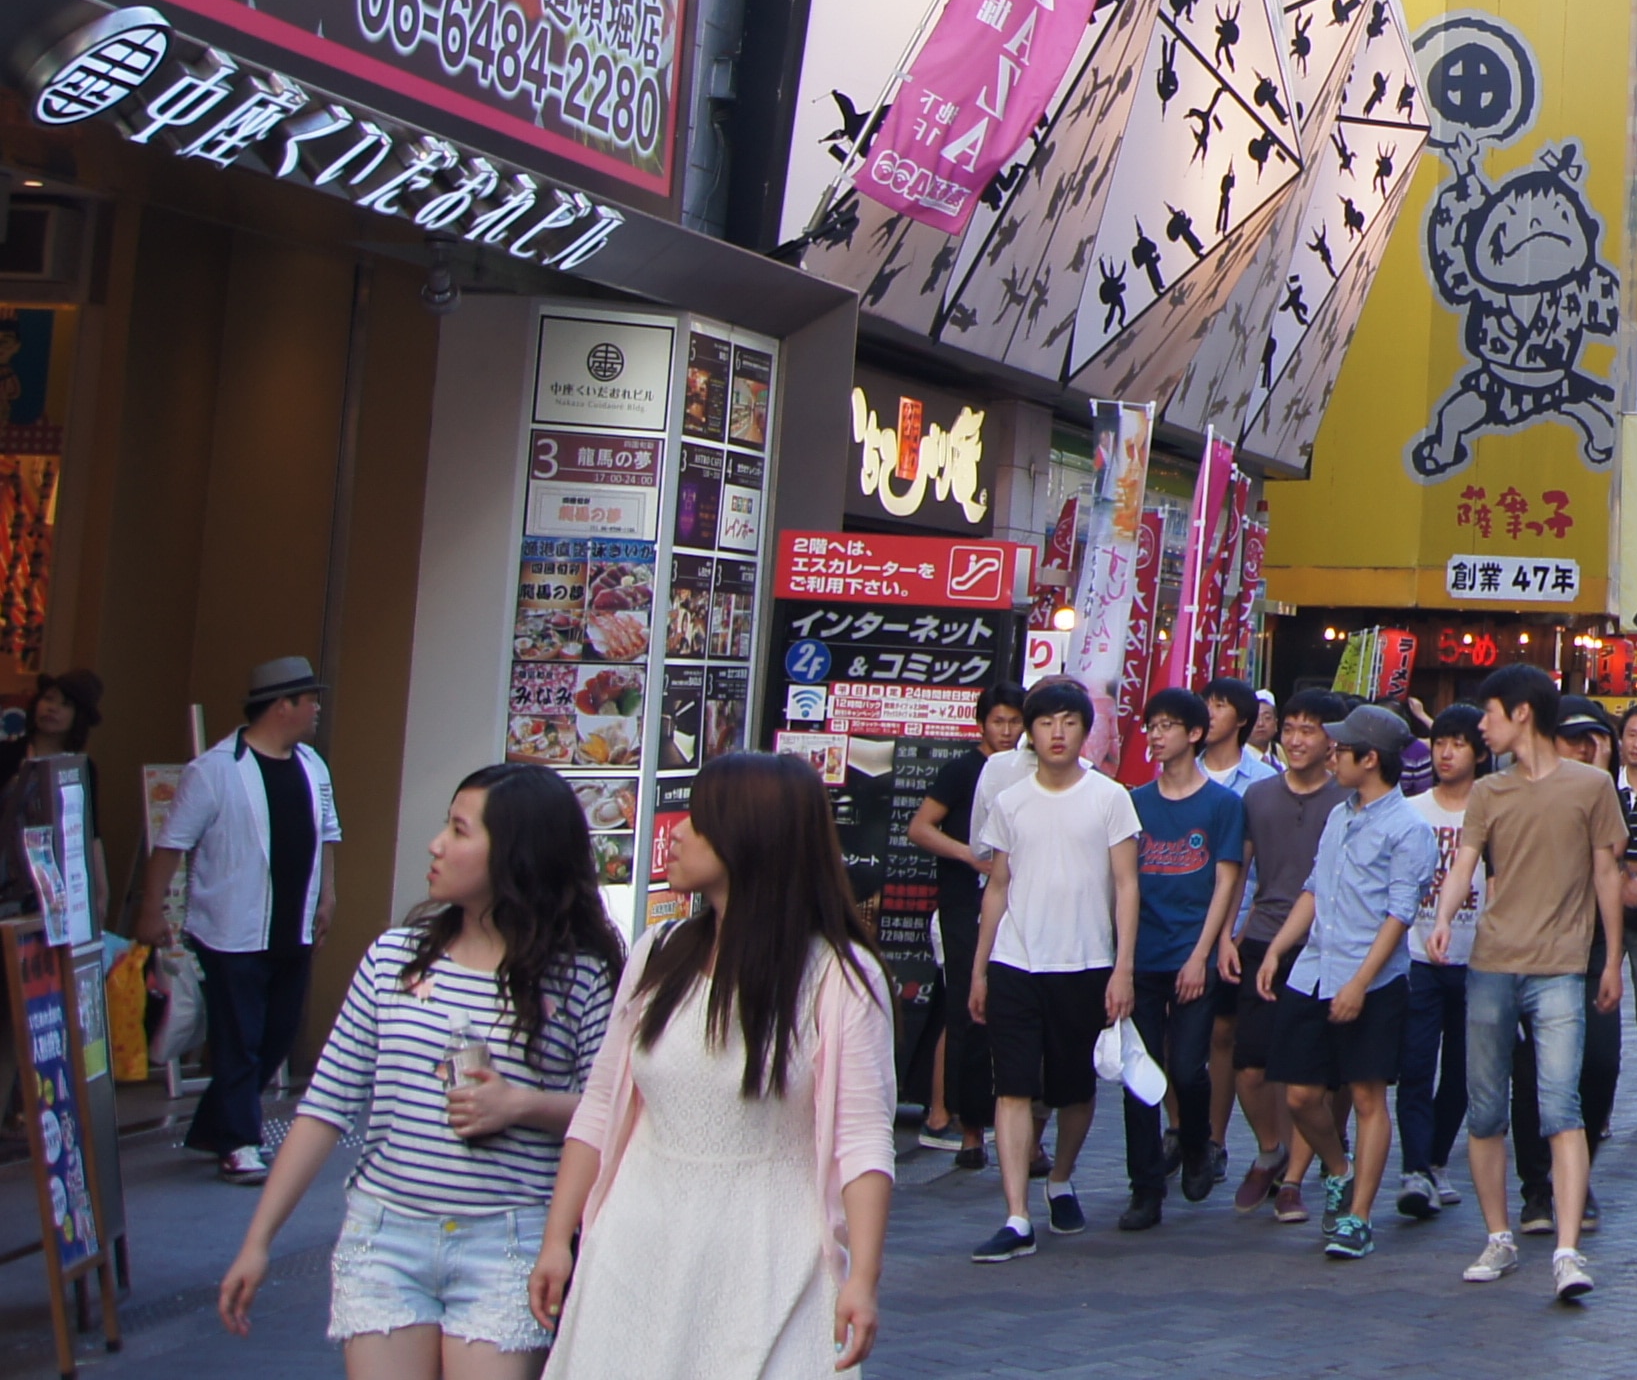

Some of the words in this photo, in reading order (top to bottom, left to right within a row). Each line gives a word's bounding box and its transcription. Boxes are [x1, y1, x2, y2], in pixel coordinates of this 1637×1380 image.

[128, 36, 626, 273] 中座くいだおれビル
[550, 381, 655, 402] 中座くいだおれビル
[533, 438, 559, 478] 3
[577, 447, 652, 470] 龍馬の夢
[594, 473, 653, 485] 17:00-24:00
[1456, 485, 1574, 540] 薩摩っ子
[793, 538, 873, 557] 2階へは、
[791, 557, 935, 579] エスカレーターを
[1452, 562, 1502, 591] 創業
[1512, 566, 1575, 594] 47年
[790, 576, 909, 597] ご利用下さい。
[792, 610, 993, 645] インターネット
[793, 643, 825, 680] 2F
[848, 656, 868, 677] &
[872, 653, 992, 684] コミック
